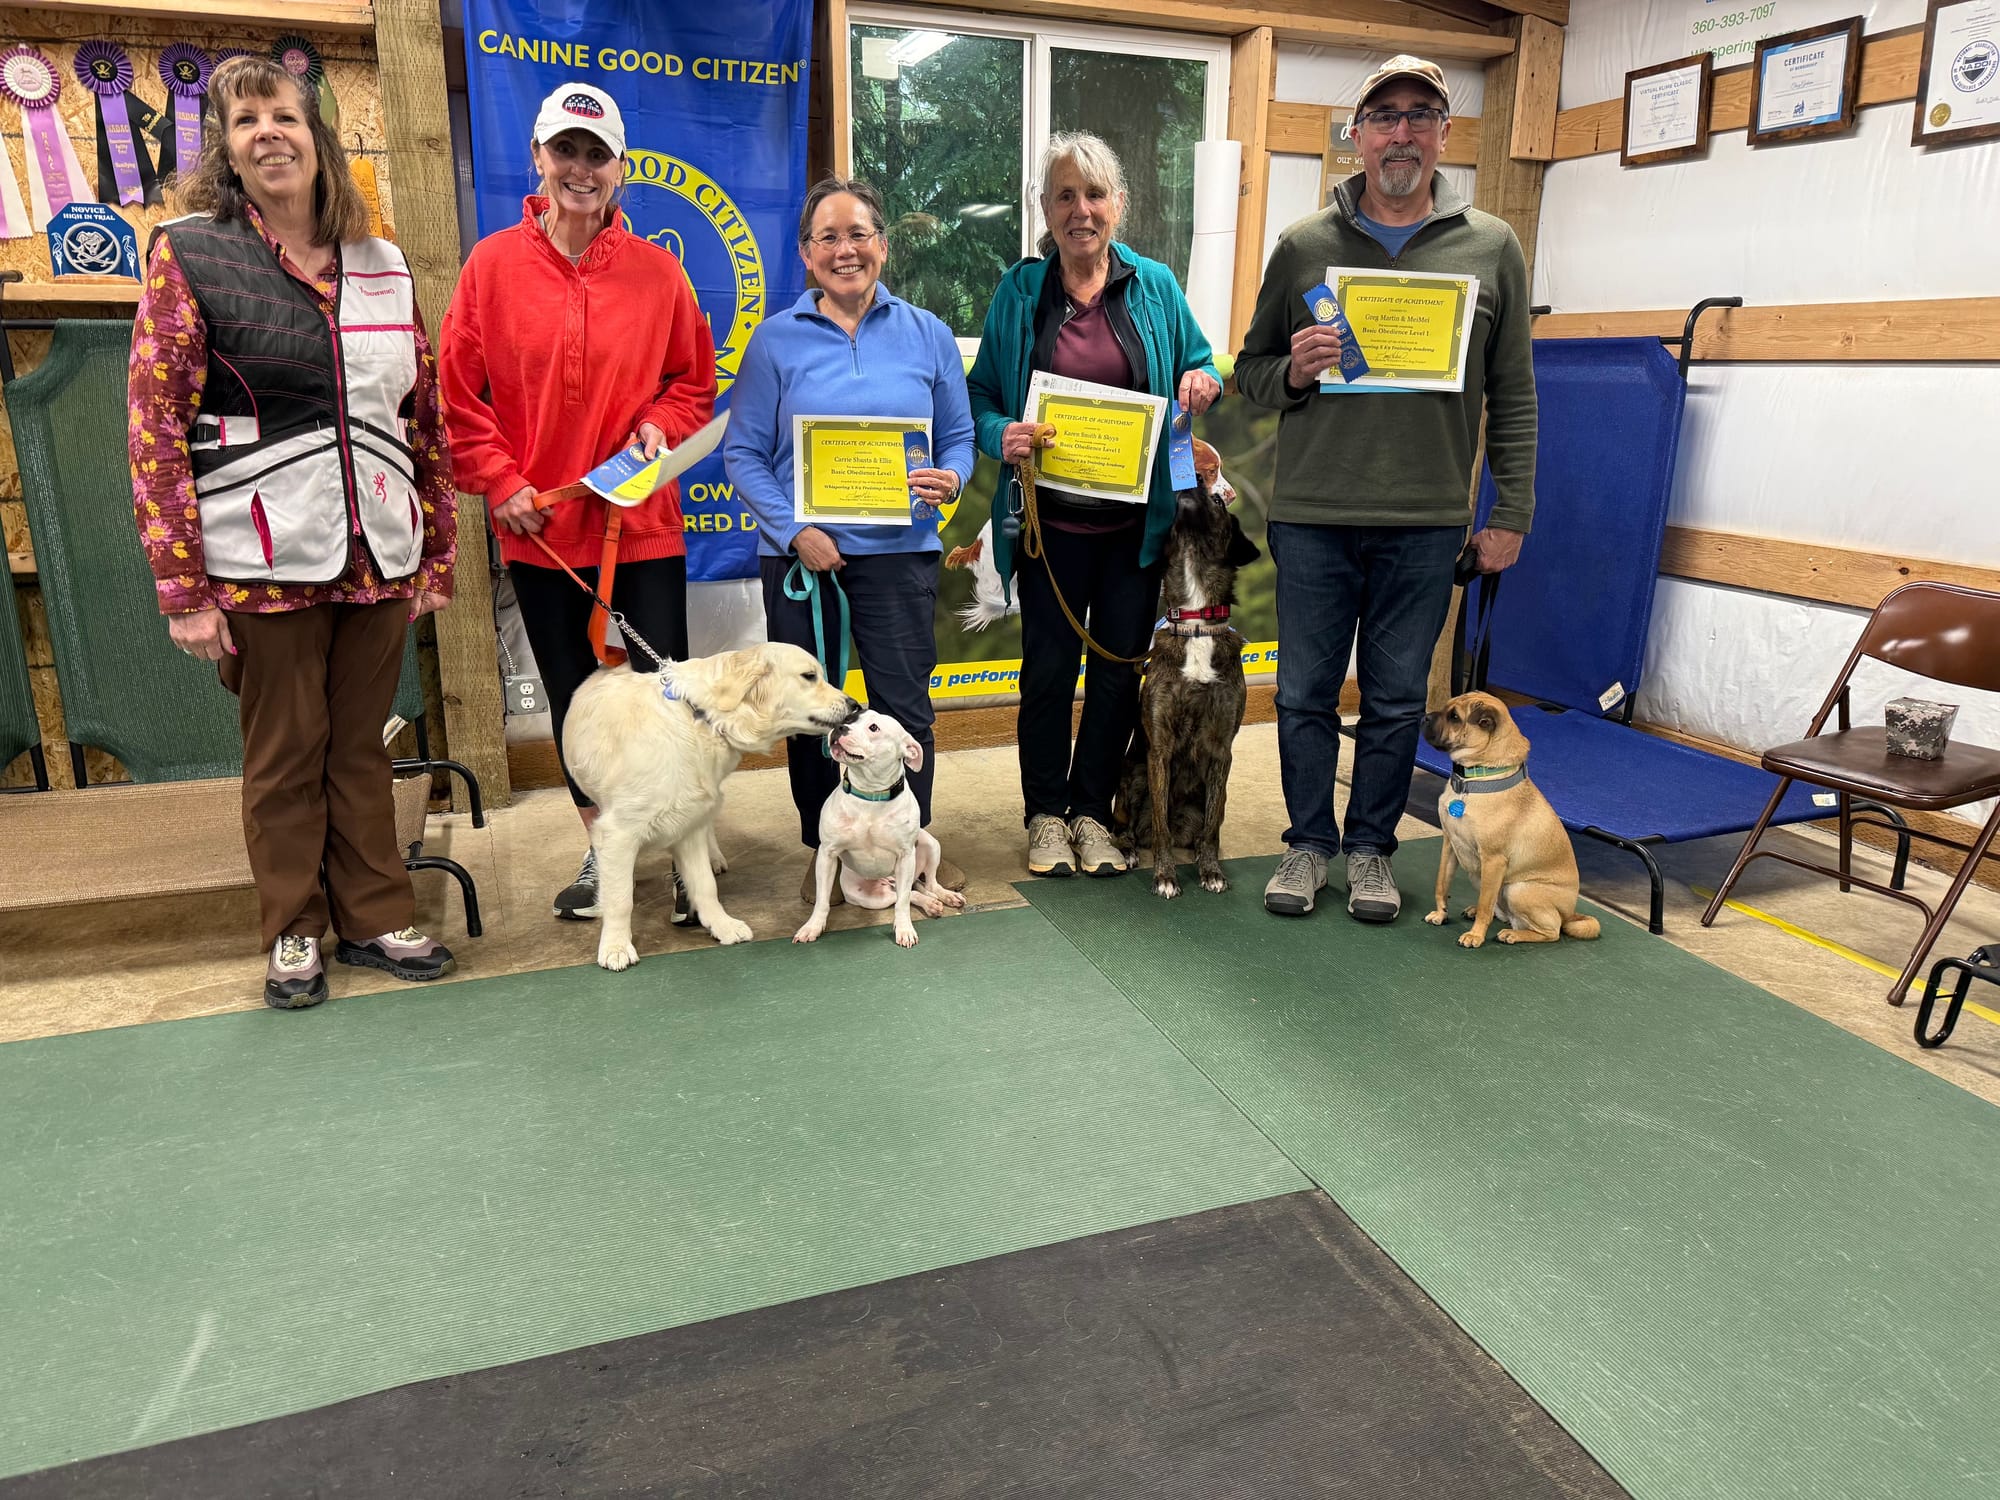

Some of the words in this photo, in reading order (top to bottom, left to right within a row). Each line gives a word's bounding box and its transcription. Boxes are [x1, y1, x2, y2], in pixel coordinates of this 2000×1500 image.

[1692, 2, 1776, 35] 360-393-7097
[478, 29, 589, 68] CANINE
[597, 49, 684, 77] GOOD
[1784, 50, 1825, 67] CERTIFICATE
[1958, 60, 1991, 72] NADOI
[1651, 90, 1679, 100] CERTIFICATE
[71, 206, 106, 214] NOVICE
[695, 183, 761, 315] CITIZEN
[1404, 298, 1444, 306] ACHIEVEMENT
[1365, 314, 1379, 322] Greg
[1380, 314, 1400, 322] Martin
[1378, 327, 1408, 336] Obedience
[1054, 413, 1088, 422] CERTIFICATE
[1097, 418, 1134, 426] ACHIEVEMENT
[1059, 441, 1074, 449] Basic
[1074, 443, 1102, 452] Obedience
[682, 513, 733, 532] RED
[930, 674, 943, 688] g
[1241, 652, 1260, 663] ce
